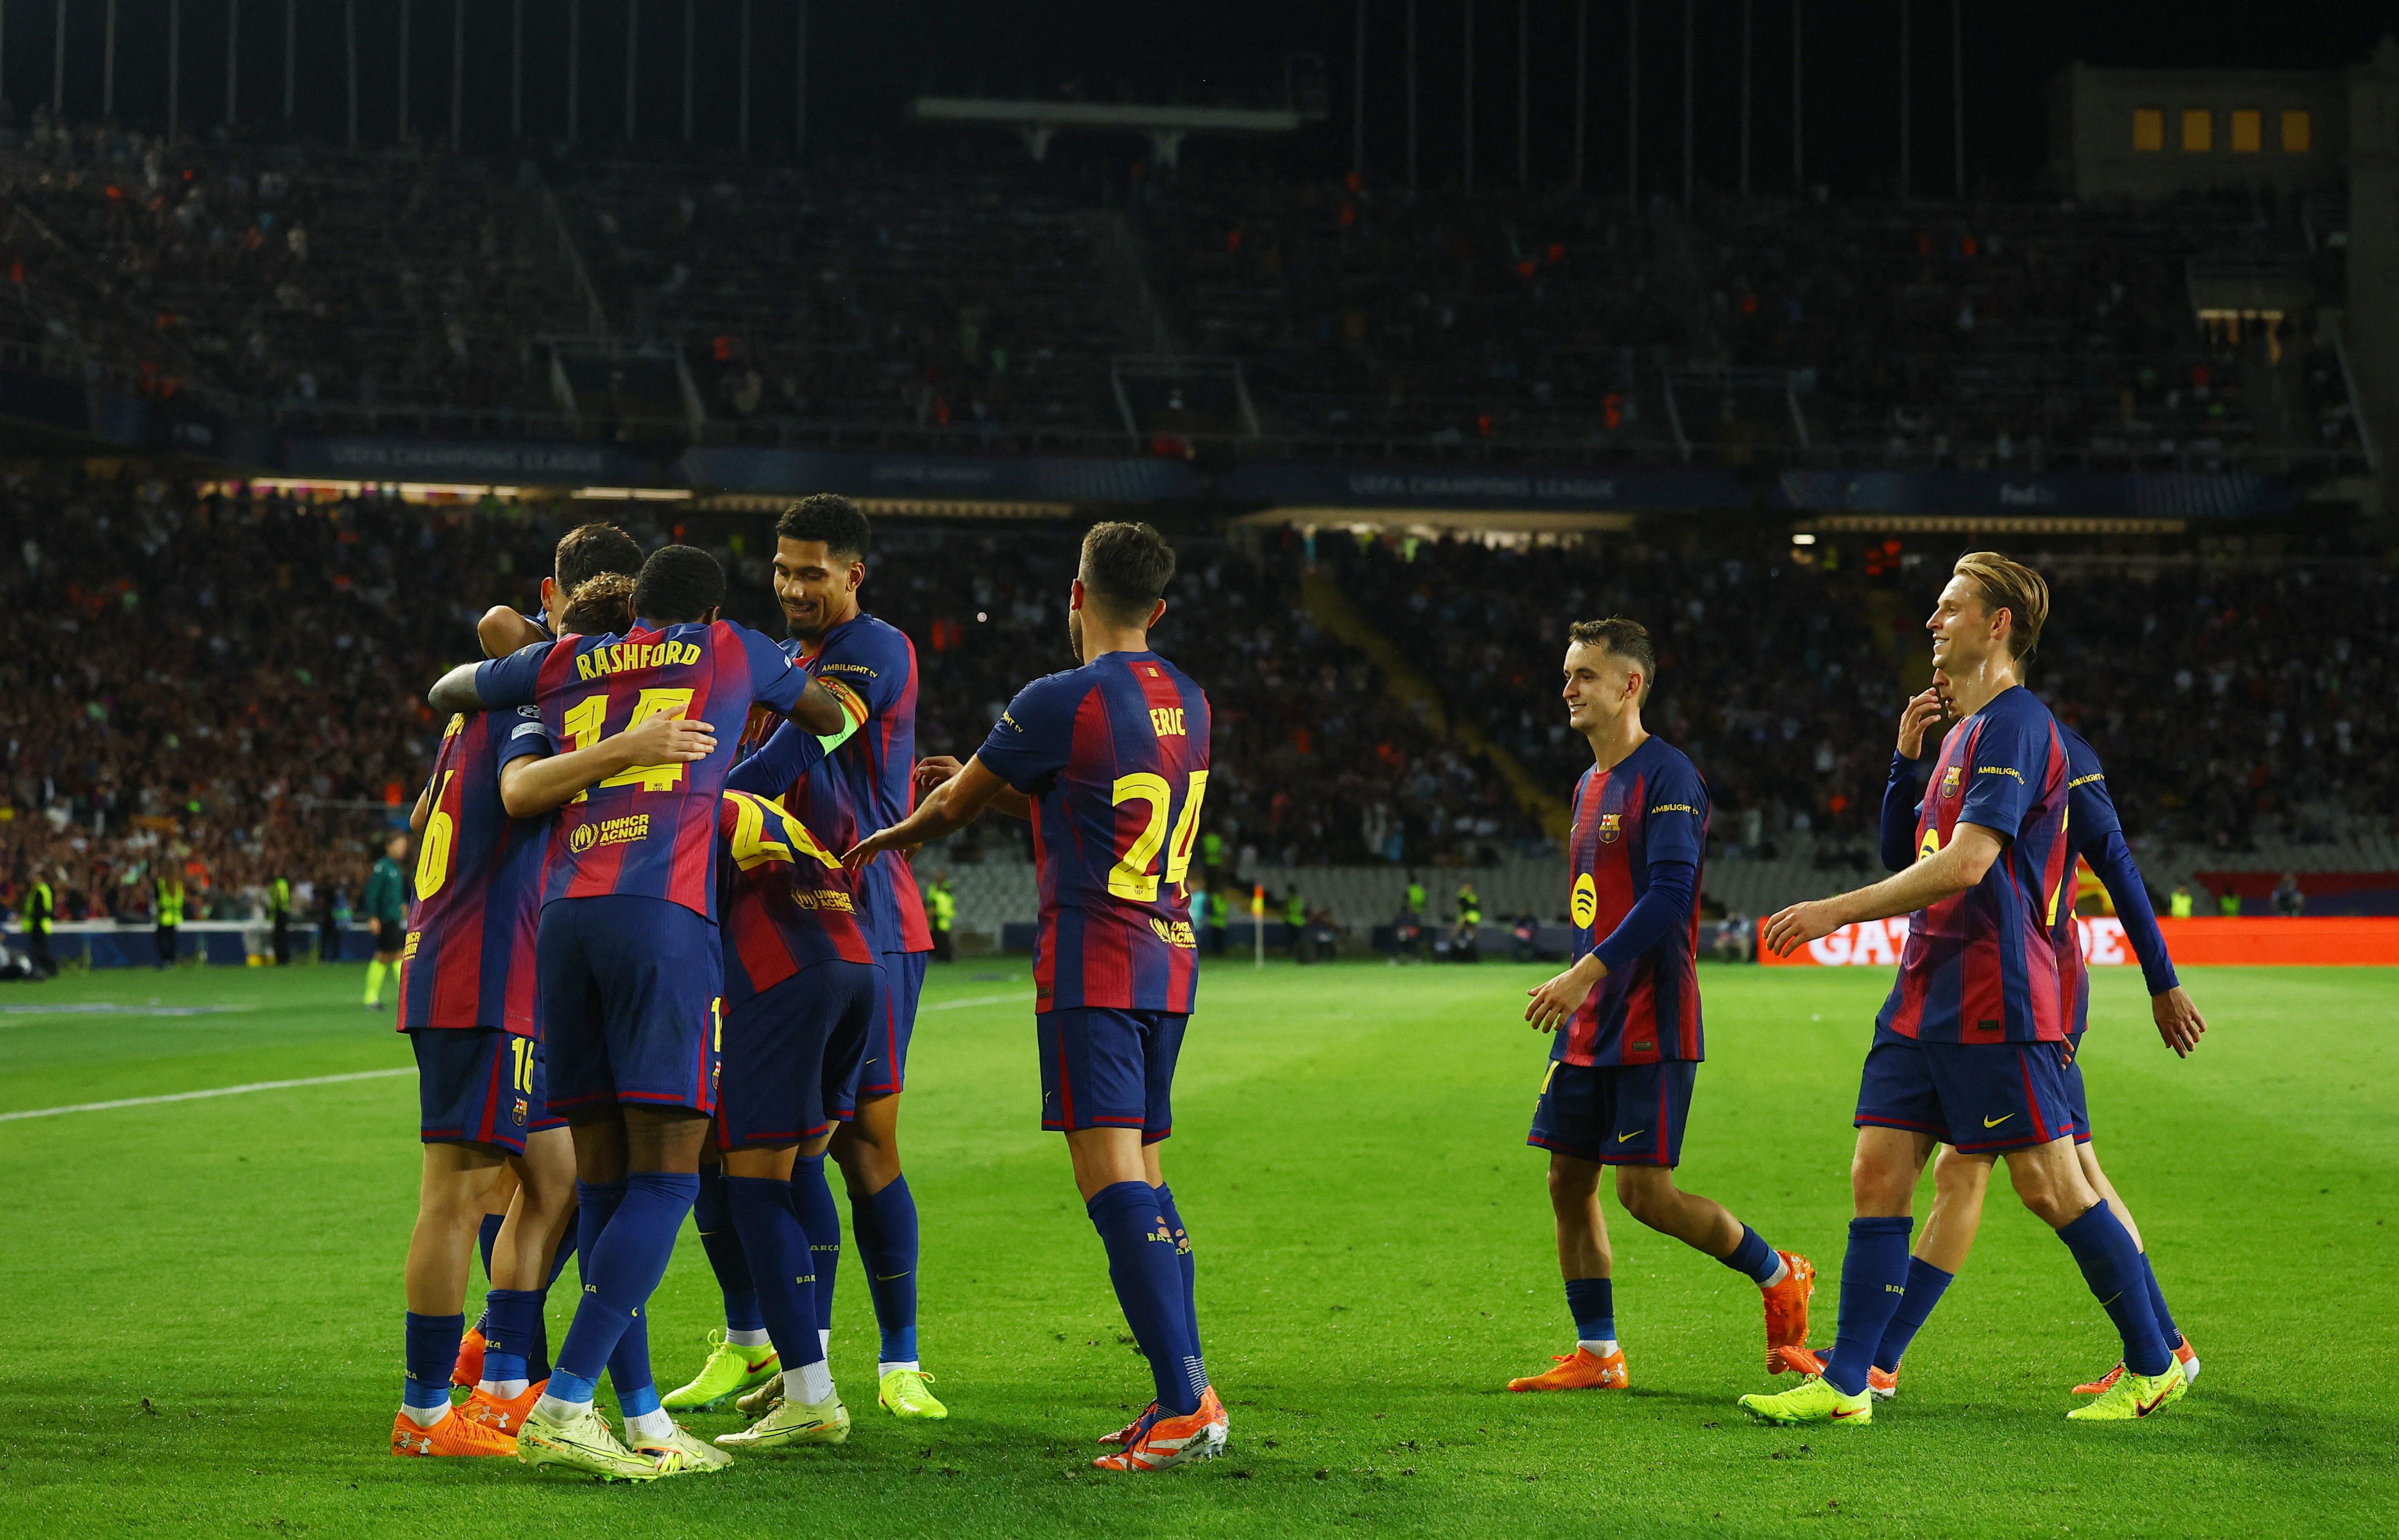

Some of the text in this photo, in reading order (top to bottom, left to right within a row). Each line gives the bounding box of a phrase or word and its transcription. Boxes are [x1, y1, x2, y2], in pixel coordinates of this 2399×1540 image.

[576, 640, 702, 680] RASHFORD
[822, 664, 878, 678] AMBILIGHT tv
[1148, 708, 1186, 737] ERIC
[564, 688, 696, 804] 14
[2068, 773, 2102, 790] MBILIGHT
[601, 814, 649, 832] UNHCR
[1651, 804, 1692, 814] AMBILIGHT
[414, 770, 454, 902] 6
[600, 825, 648, 842] ACNUR
[1108, 770, 1209, 902] 24
[710, 997, 722, 1052] 1
[512, 1037, 534, 1094] 16
